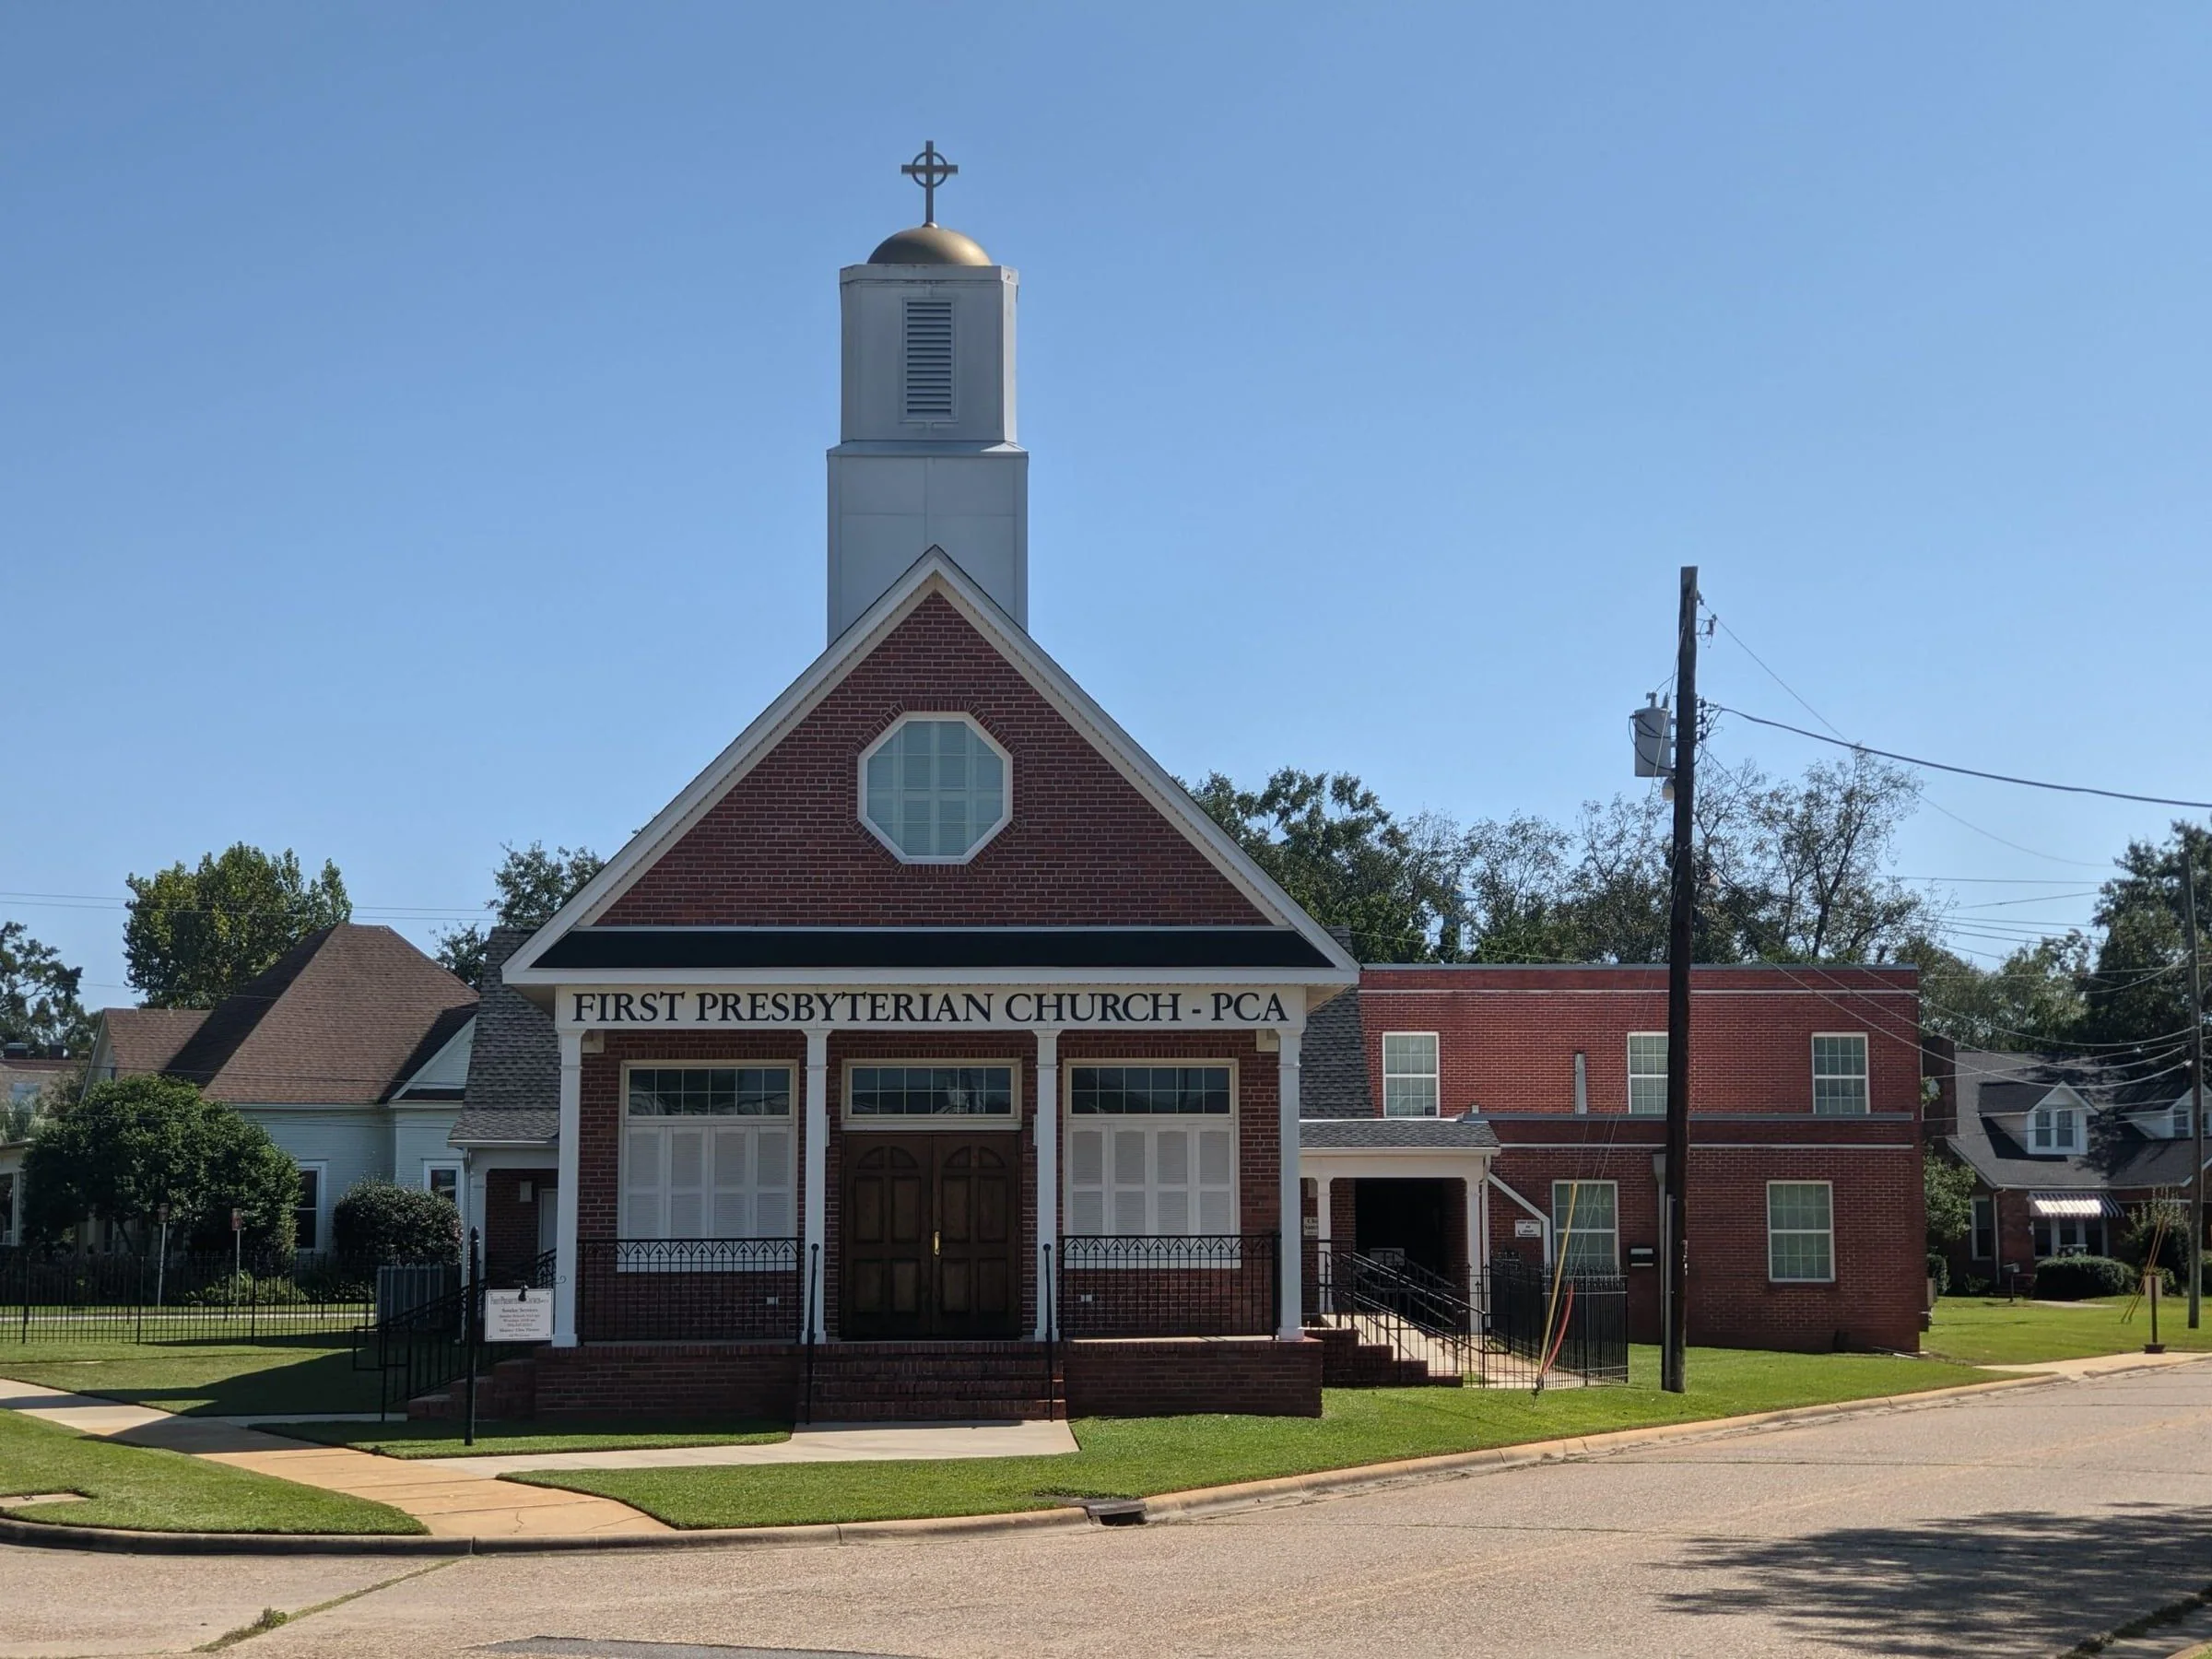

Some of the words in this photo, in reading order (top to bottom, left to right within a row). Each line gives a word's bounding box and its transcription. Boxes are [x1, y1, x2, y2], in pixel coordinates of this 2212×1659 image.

[572, 991, 686, 1022] FIRST
[695, 991, 994, 1022] PRESBYTERIAN
[1005, 993, 1182, 1022] CHURCH
[1210, 993, 1290, 1022] PCA
